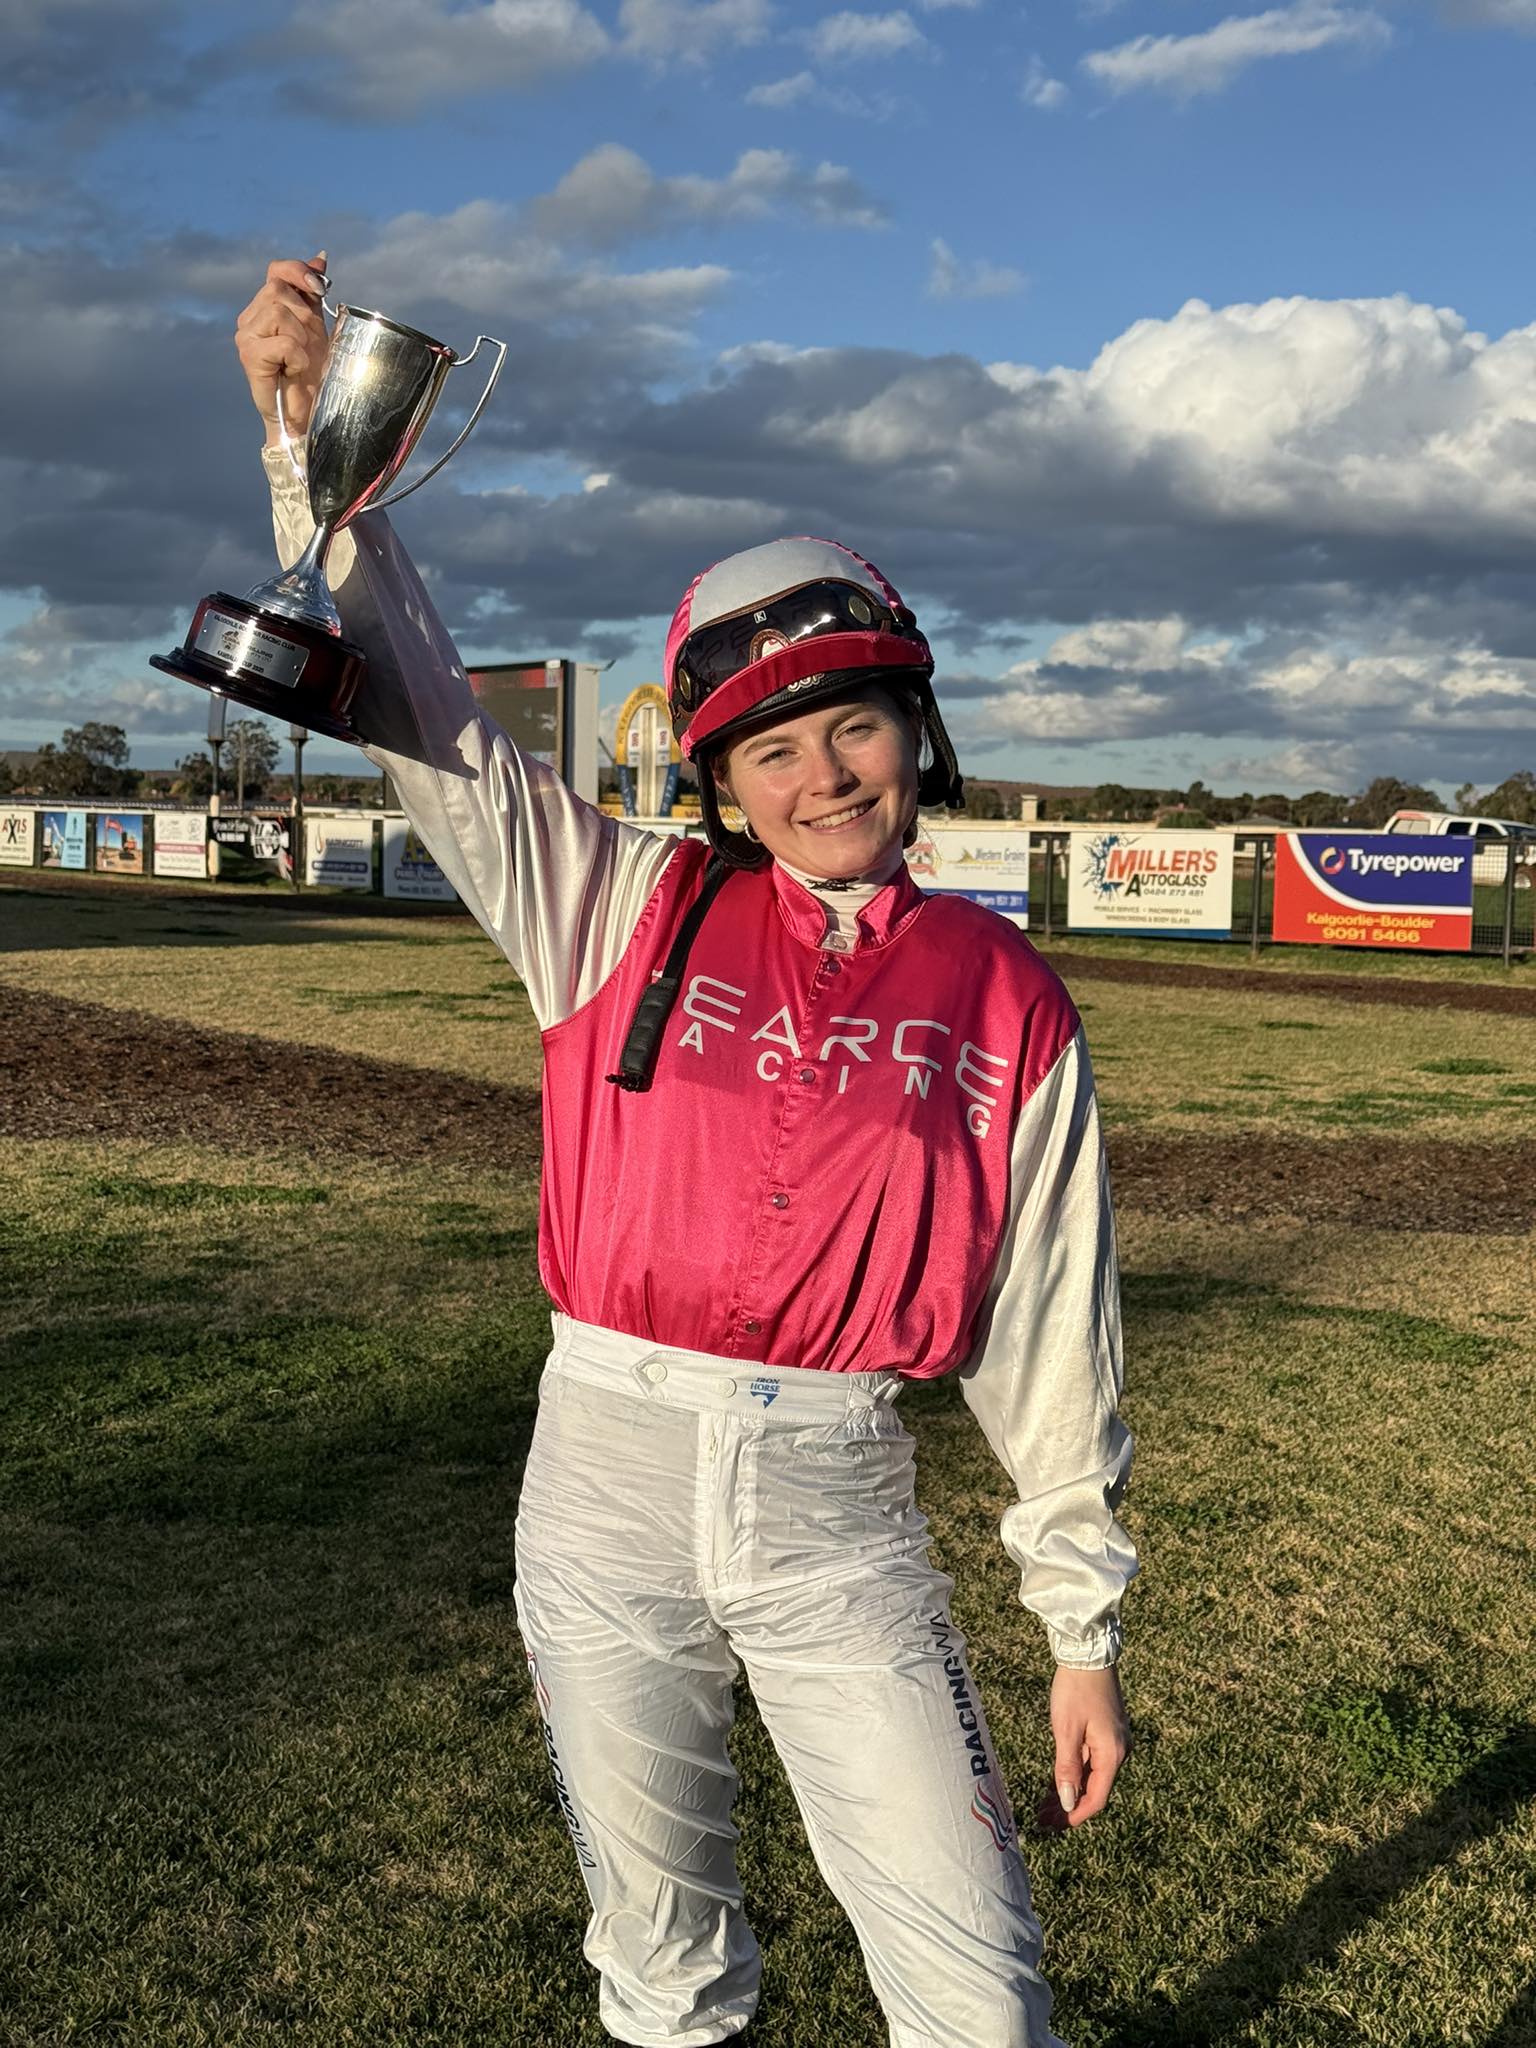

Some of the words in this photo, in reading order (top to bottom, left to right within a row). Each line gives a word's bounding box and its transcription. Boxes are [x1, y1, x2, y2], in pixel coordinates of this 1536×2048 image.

[2, 814, 27, 844] AXIS
[1107, 848, 1217, 882] MILLER'S
[1348, 848, 1464, 878] Tyrepower
[1124, 873, 1207, 897] AUTOGLASS
[1306, 912, 1435, 929] Kalgoorlie-Boulder
[1322, 927, 1366, 941] 9091
[1372, 929, 1420, 943] 5466
[682, 974, 1009, 1107] EARCE
[678, 1021, 991, 1139] ACING
[750, 1382, 781, 1392] HORSE
